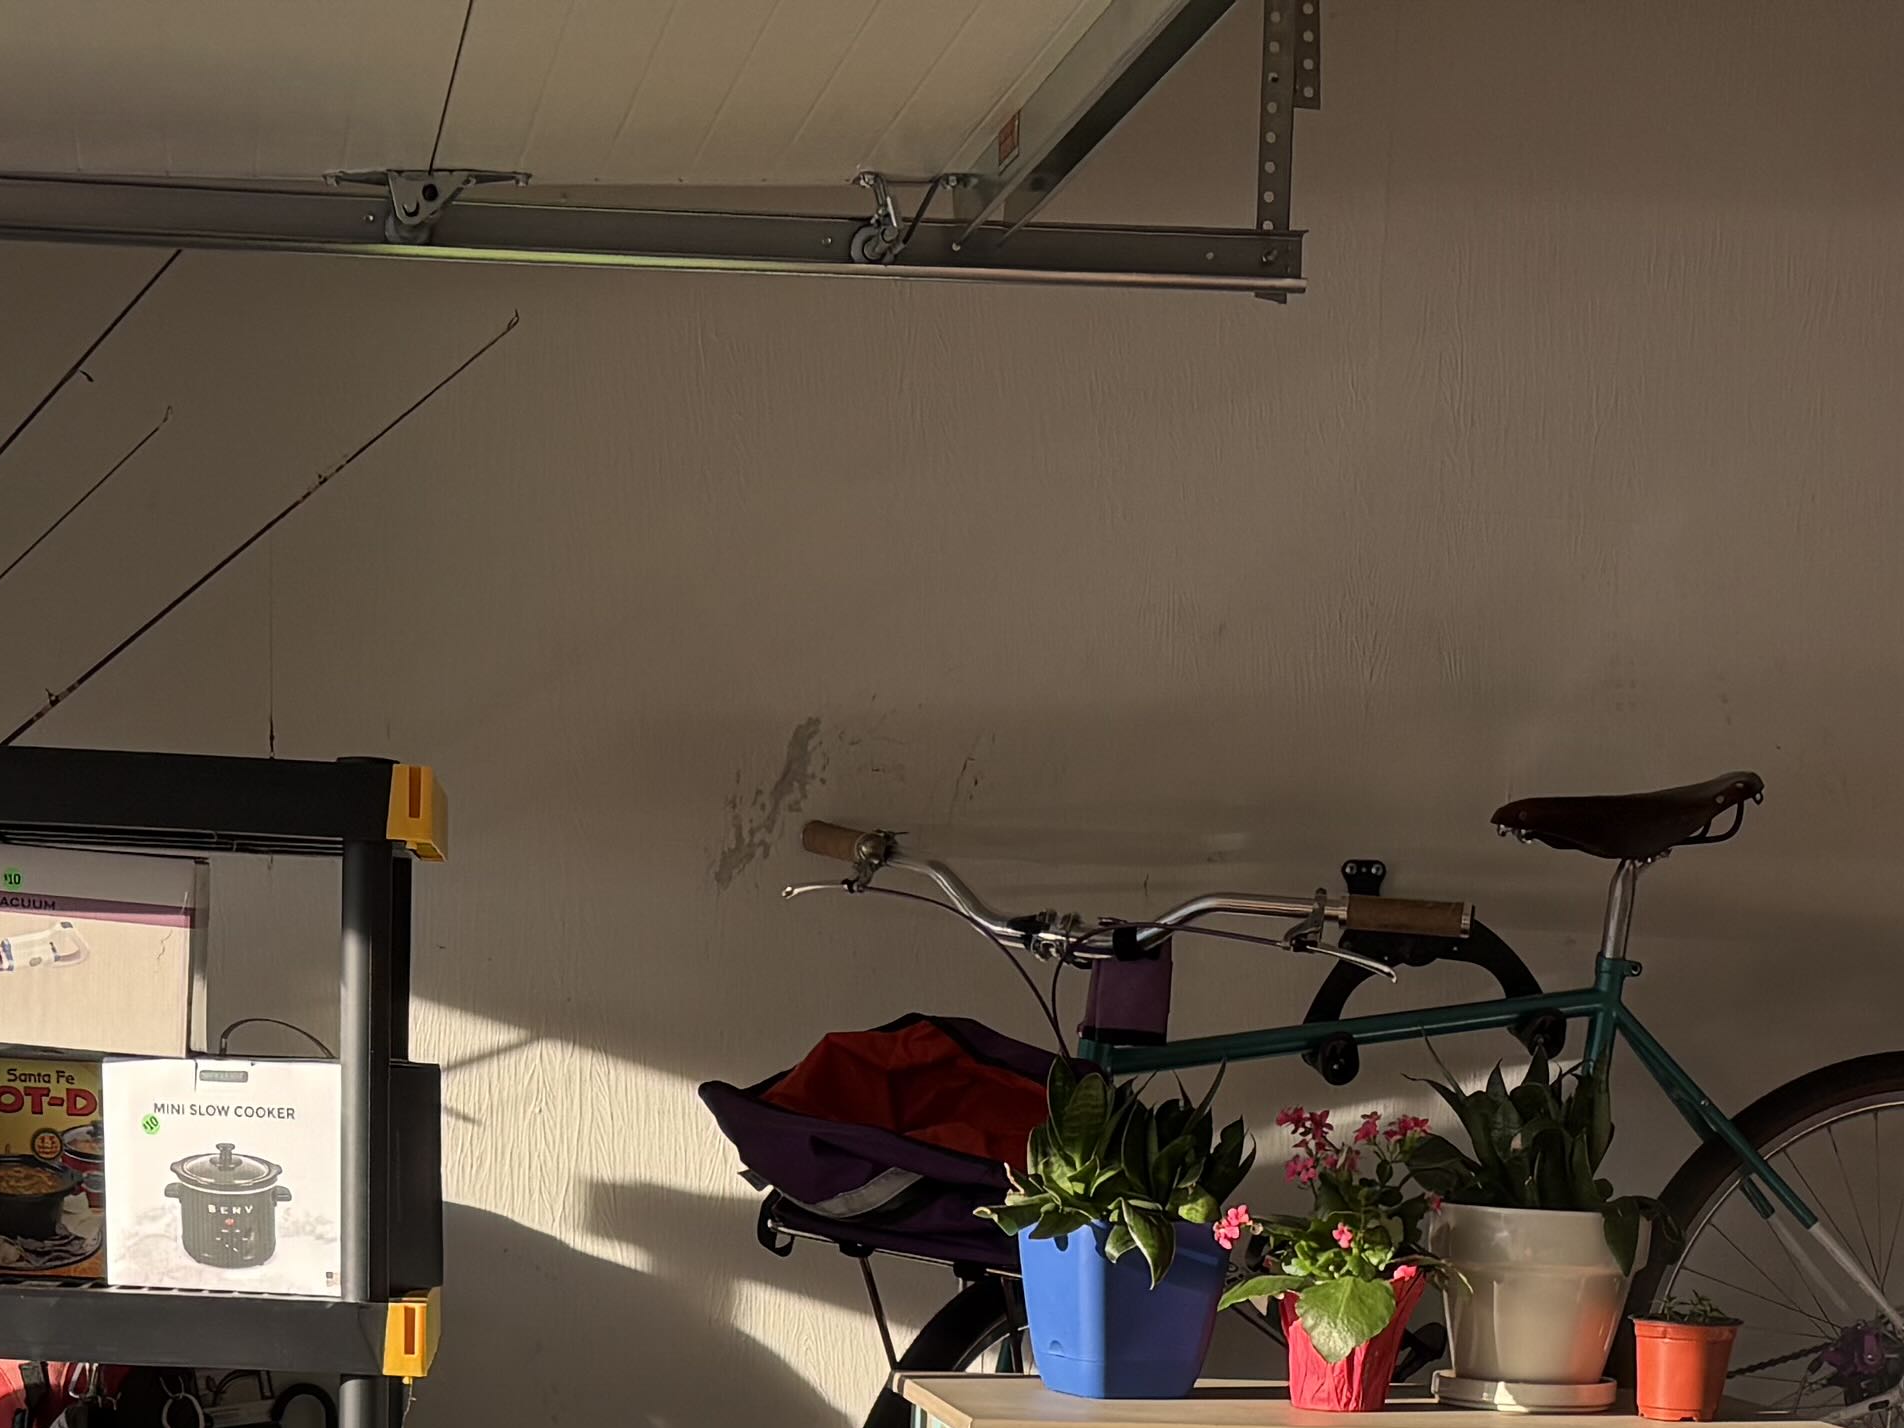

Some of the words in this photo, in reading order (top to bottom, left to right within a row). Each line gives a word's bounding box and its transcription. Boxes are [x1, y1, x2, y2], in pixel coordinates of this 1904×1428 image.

[4, 873, 21, 886] $10
[7, 1069, 52, 1085] Santa
[56, 1070, 76, 1086] Fe
[153, 1102, 186, 1116] MINI
[189, 1103, 231, 1118] SLOW
[234, 1105, 296, 1121] COOKER
